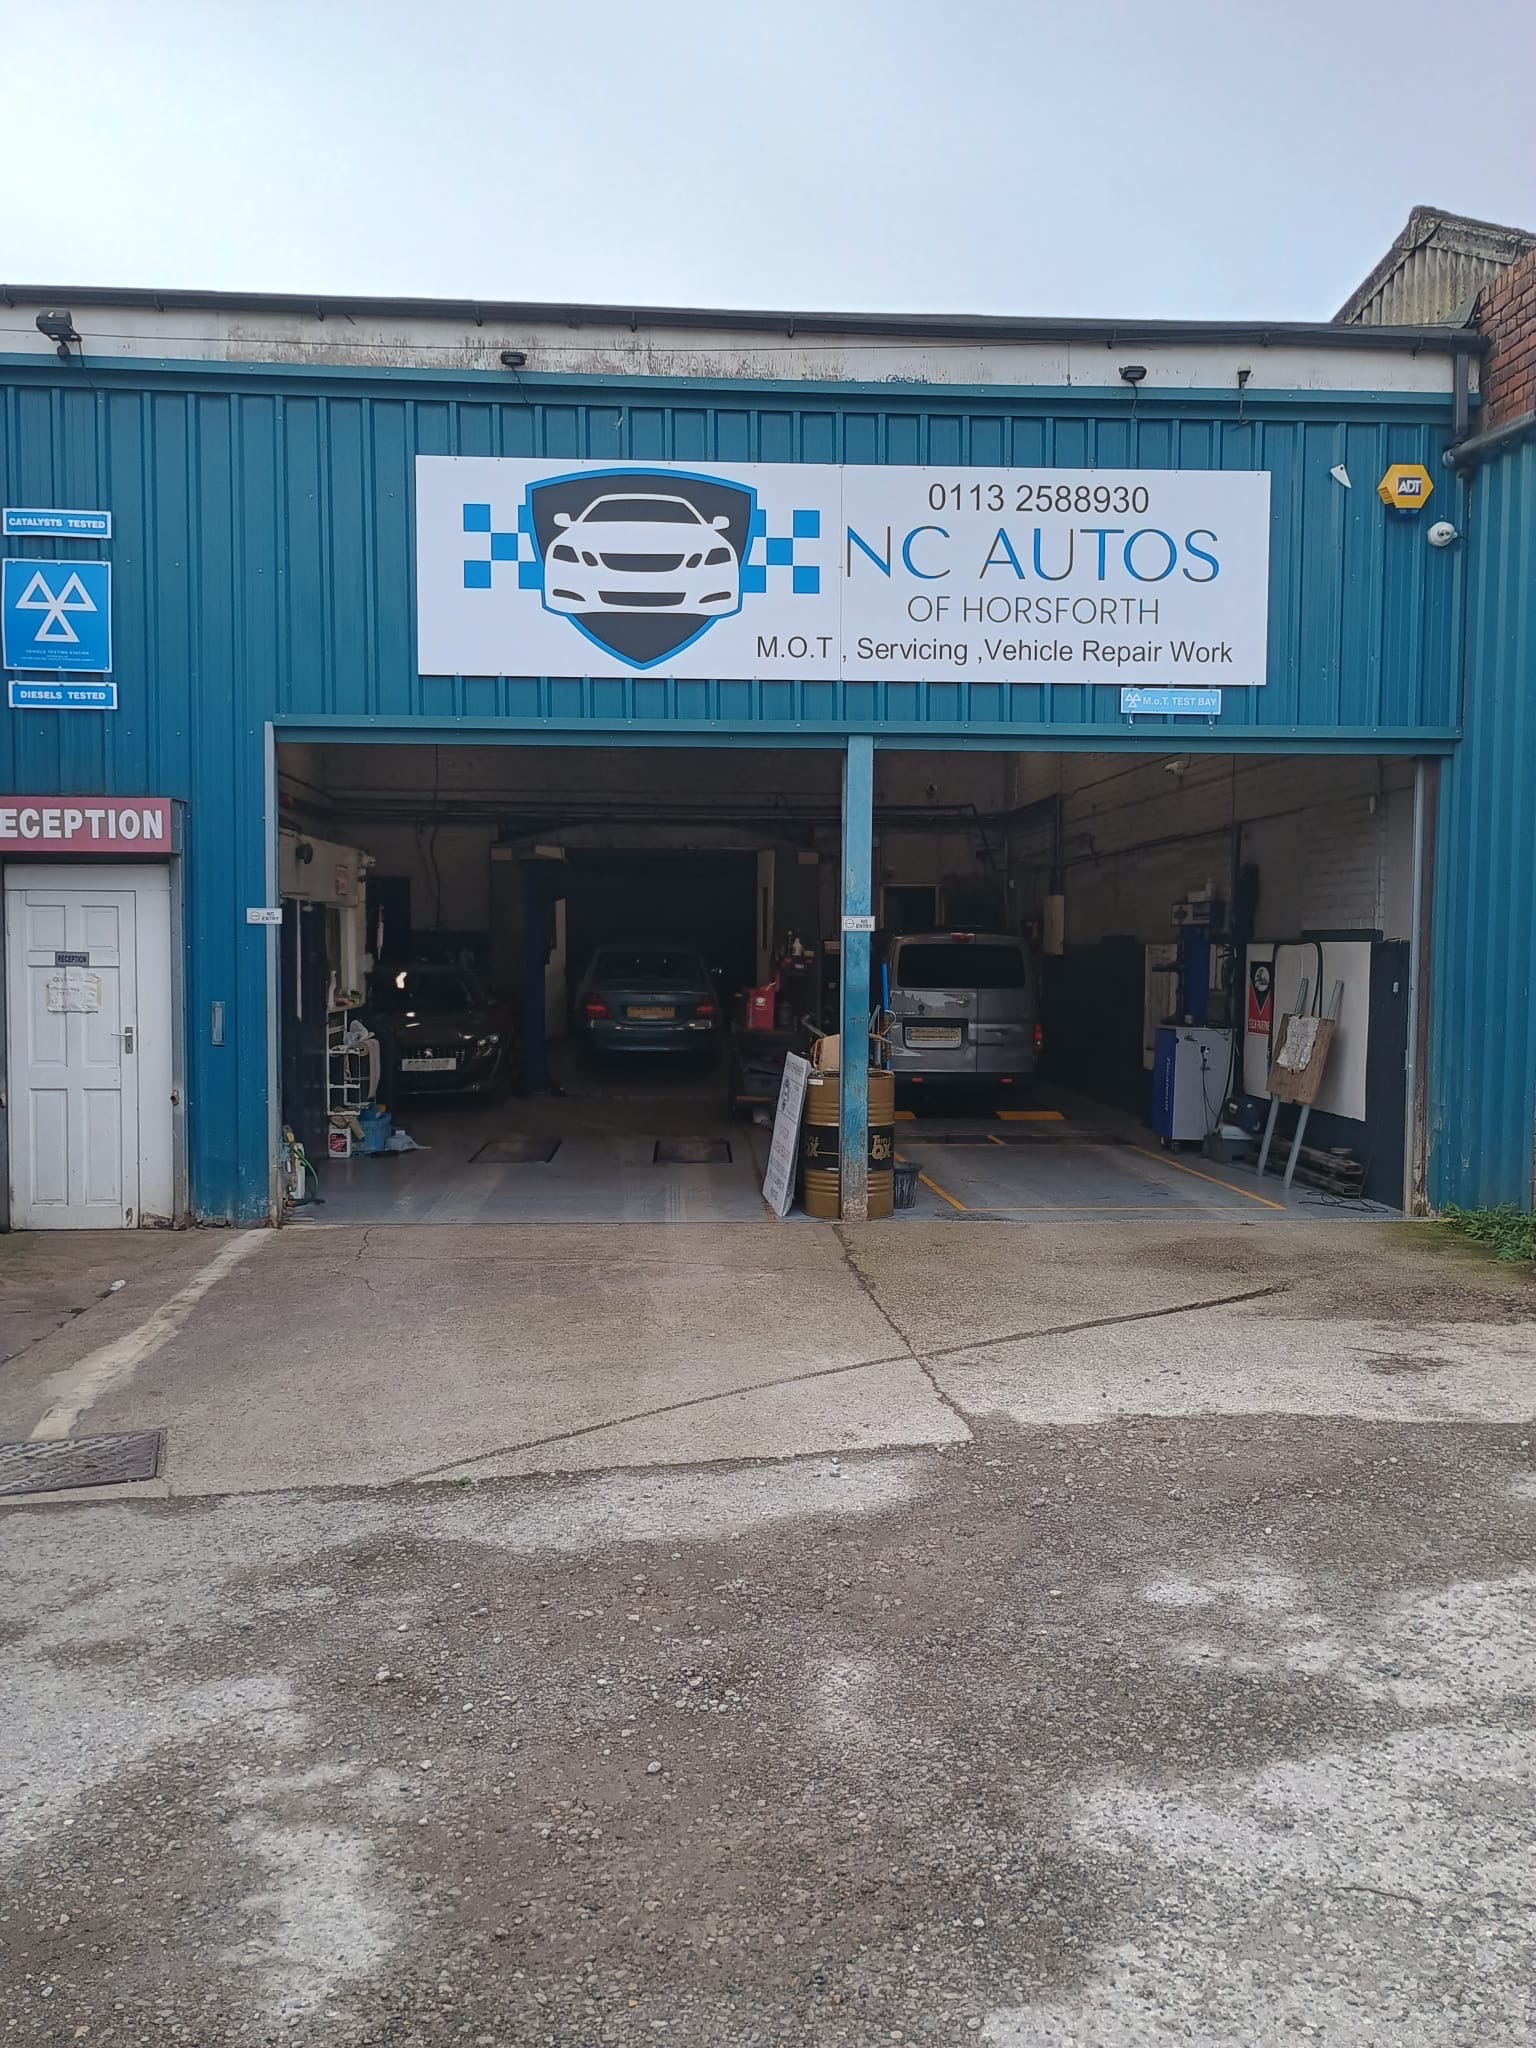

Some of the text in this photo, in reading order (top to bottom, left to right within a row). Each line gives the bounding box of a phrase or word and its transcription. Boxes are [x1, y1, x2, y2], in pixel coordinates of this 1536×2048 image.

[929, 484, 1150, 514] 0113 2588930
[1398, 479, 1422, 494] ADT
[8, 517, 106, 530] CATALYSTS TESTED
[847, 525, 1220, 583] NC AUTOS
[907, 595, 1160, 625] OF HORSFORTH
[857, 637, 968, 666] Servicing
[1082, 640, 1163, 668] Repair
[1170, 640, 1233, 663] Work
[20, 690, 106, 701] DIESELS TESTED
[1172, 697, 1196, 706] TEST
[1198, 698, 1217, 706] BAY
[0, 808, 163, 839] ECEPTION
